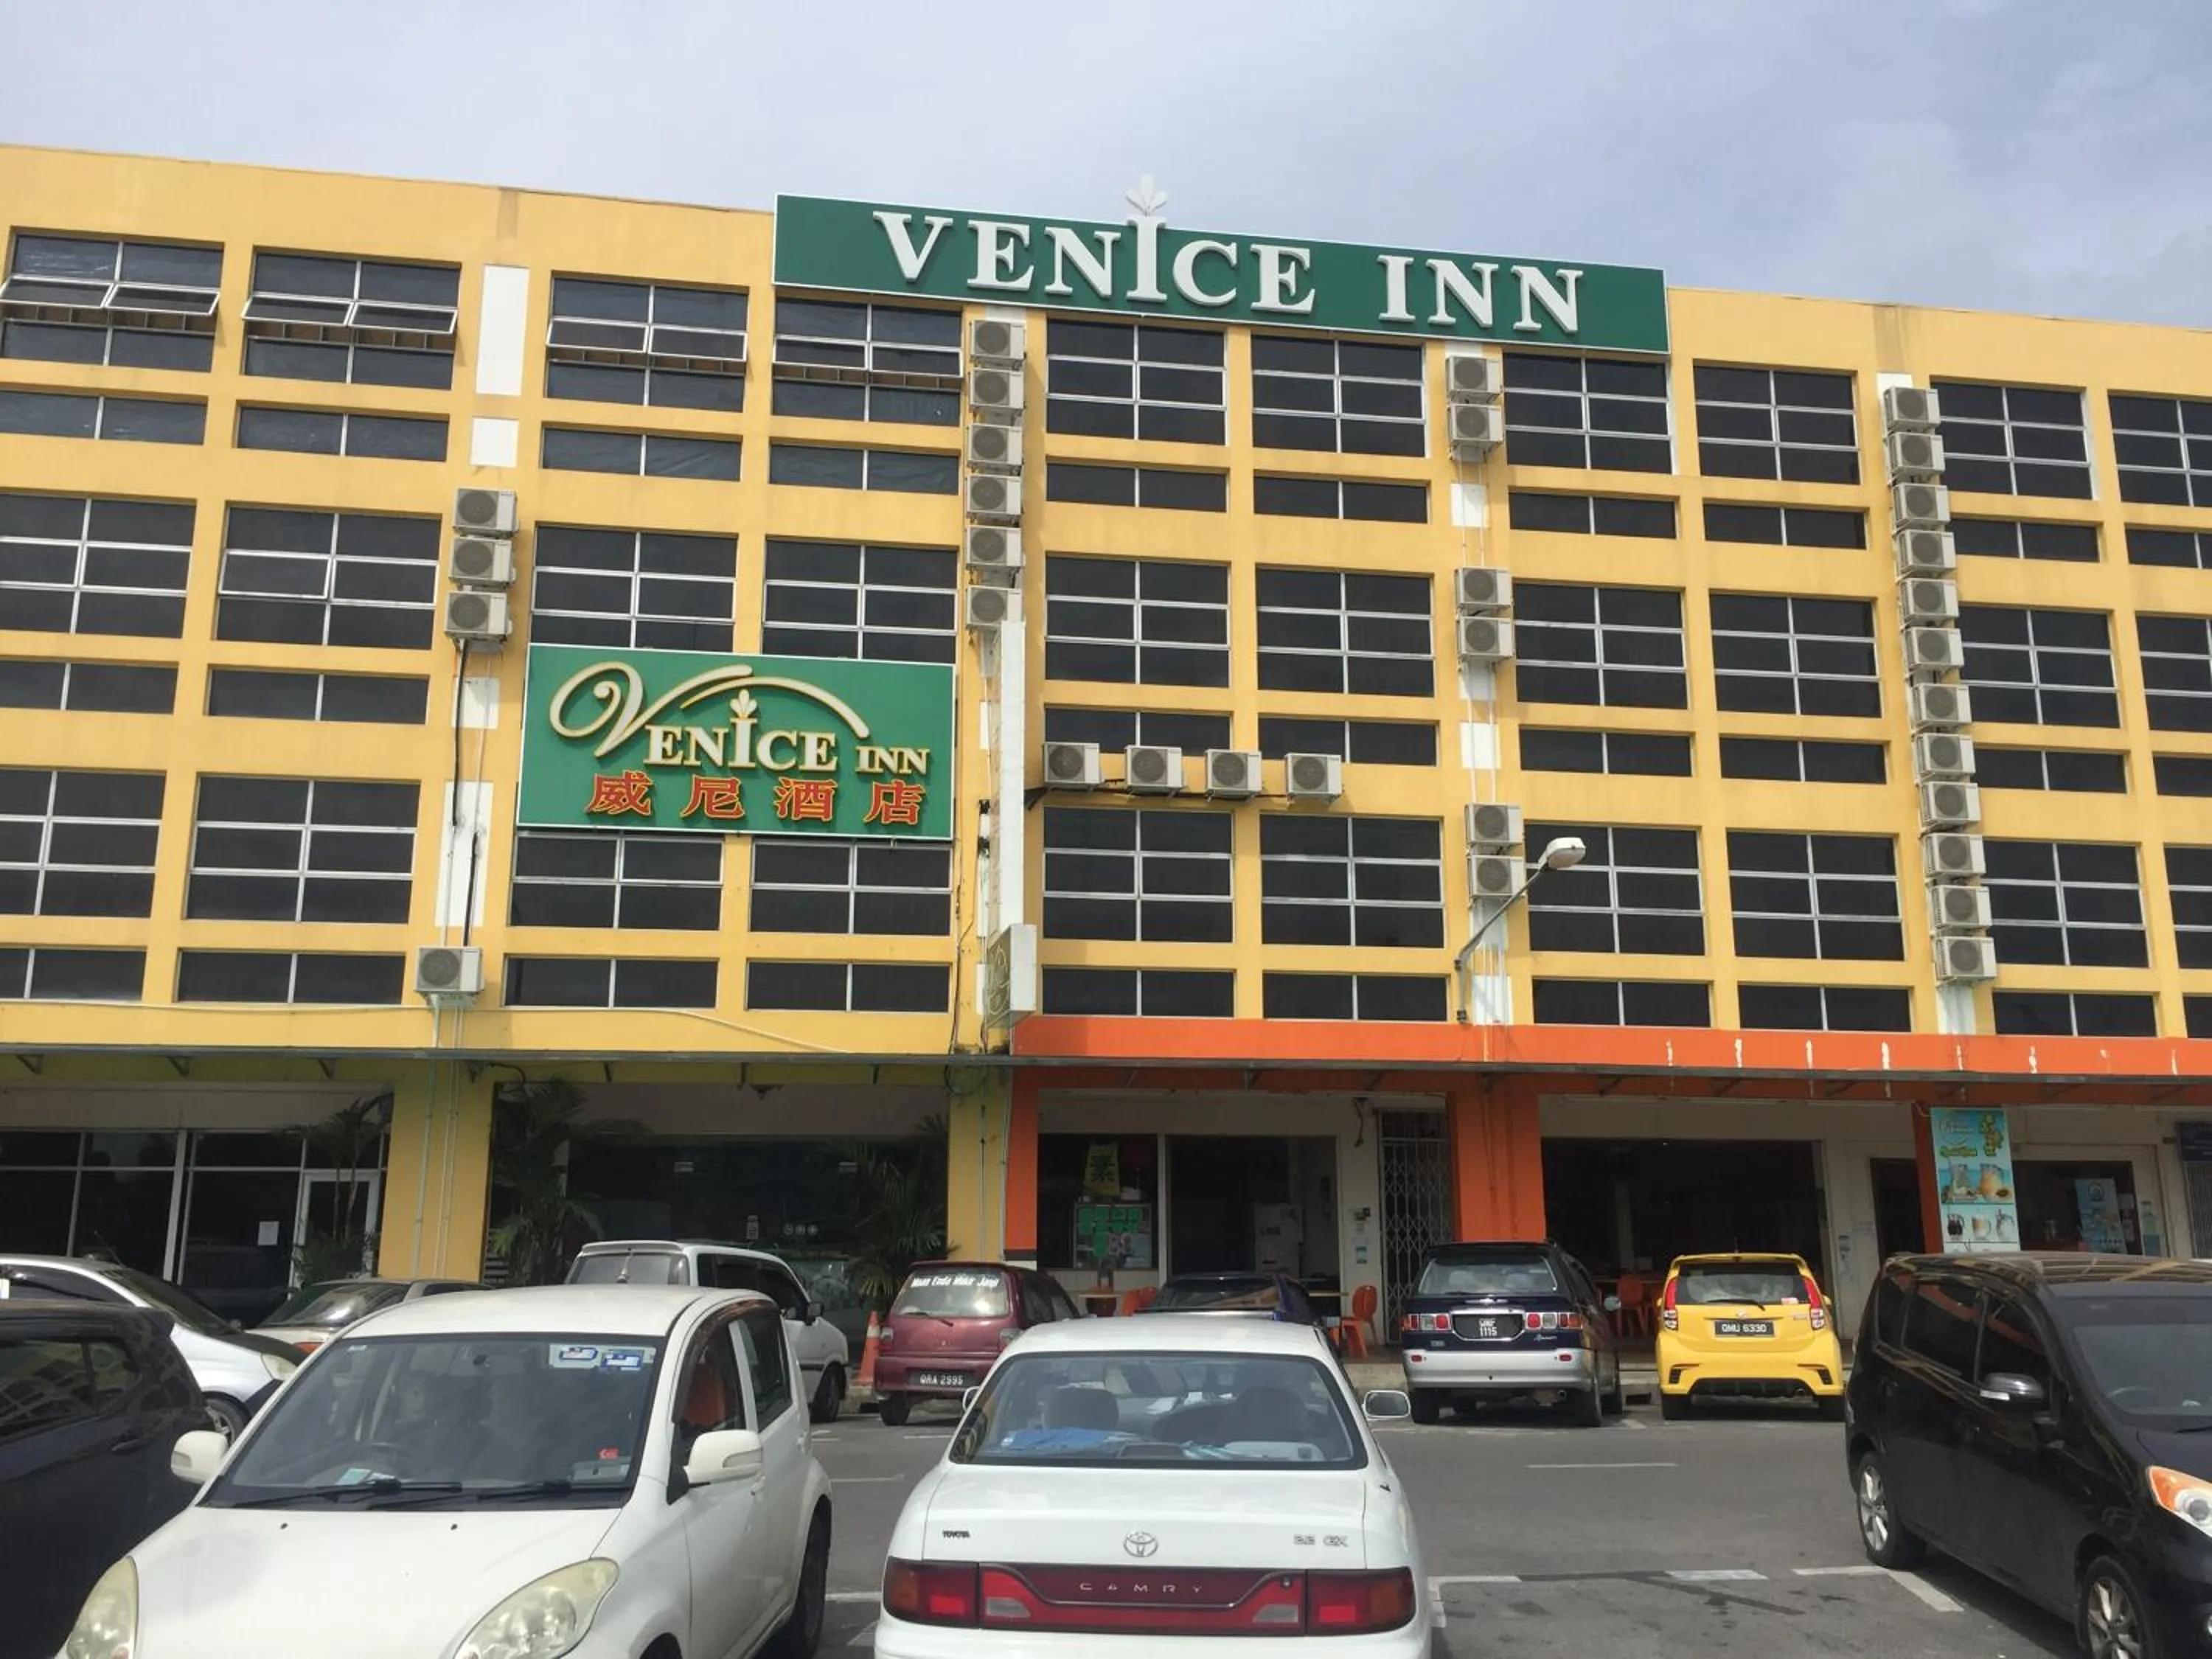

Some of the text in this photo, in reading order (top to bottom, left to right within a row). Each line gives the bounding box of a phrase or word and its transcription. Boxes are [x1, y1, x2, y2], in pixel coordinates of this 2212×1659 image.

[873, 211, 1584, 334] VENICE INN
[549, 661, 931, 776] VENICE INN
[584, 770, 927, 827] 威尼酒店
[942, 1530, 970, 1539] TOYOTA
[1079, 1582, 1203, 1594] CAMRY
